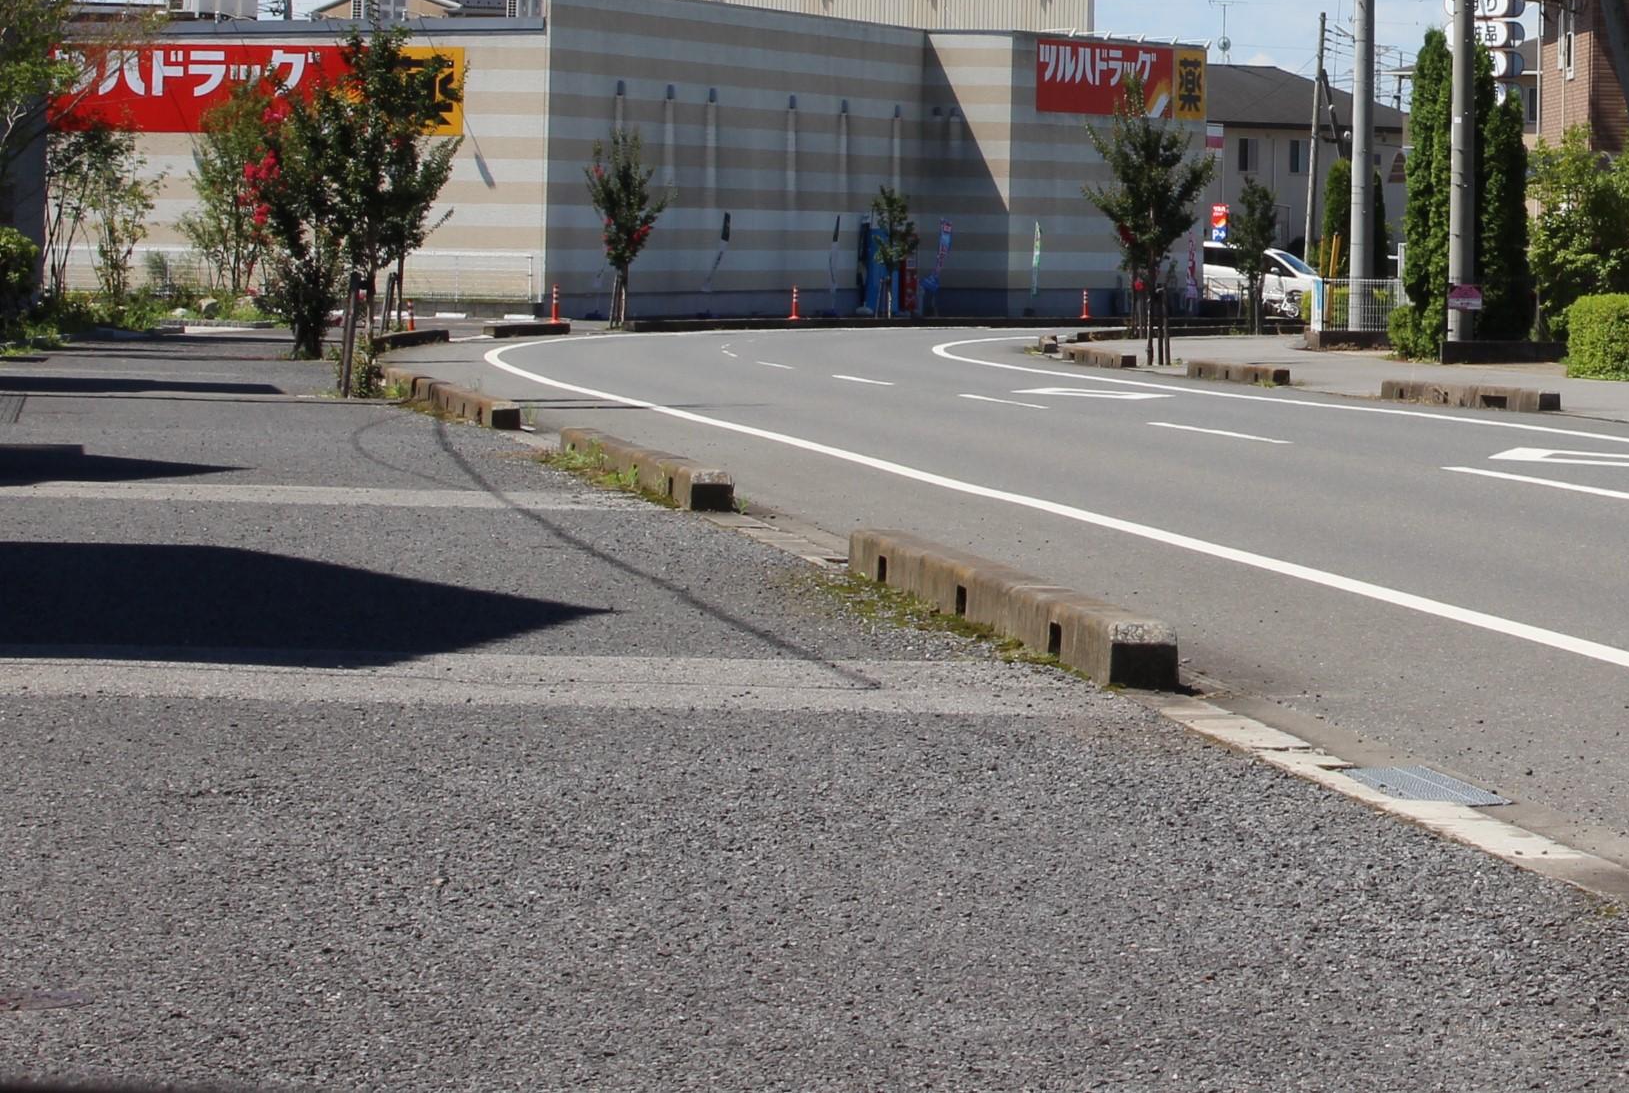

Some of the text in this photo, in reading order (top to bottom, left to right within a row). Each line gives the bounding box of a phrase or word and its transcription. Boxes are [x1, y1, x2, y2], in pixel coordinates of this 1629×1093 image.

[1039, 44, 1157, 87] ツルハドラッグ
[1179, 58, 1201, 112] 薬
